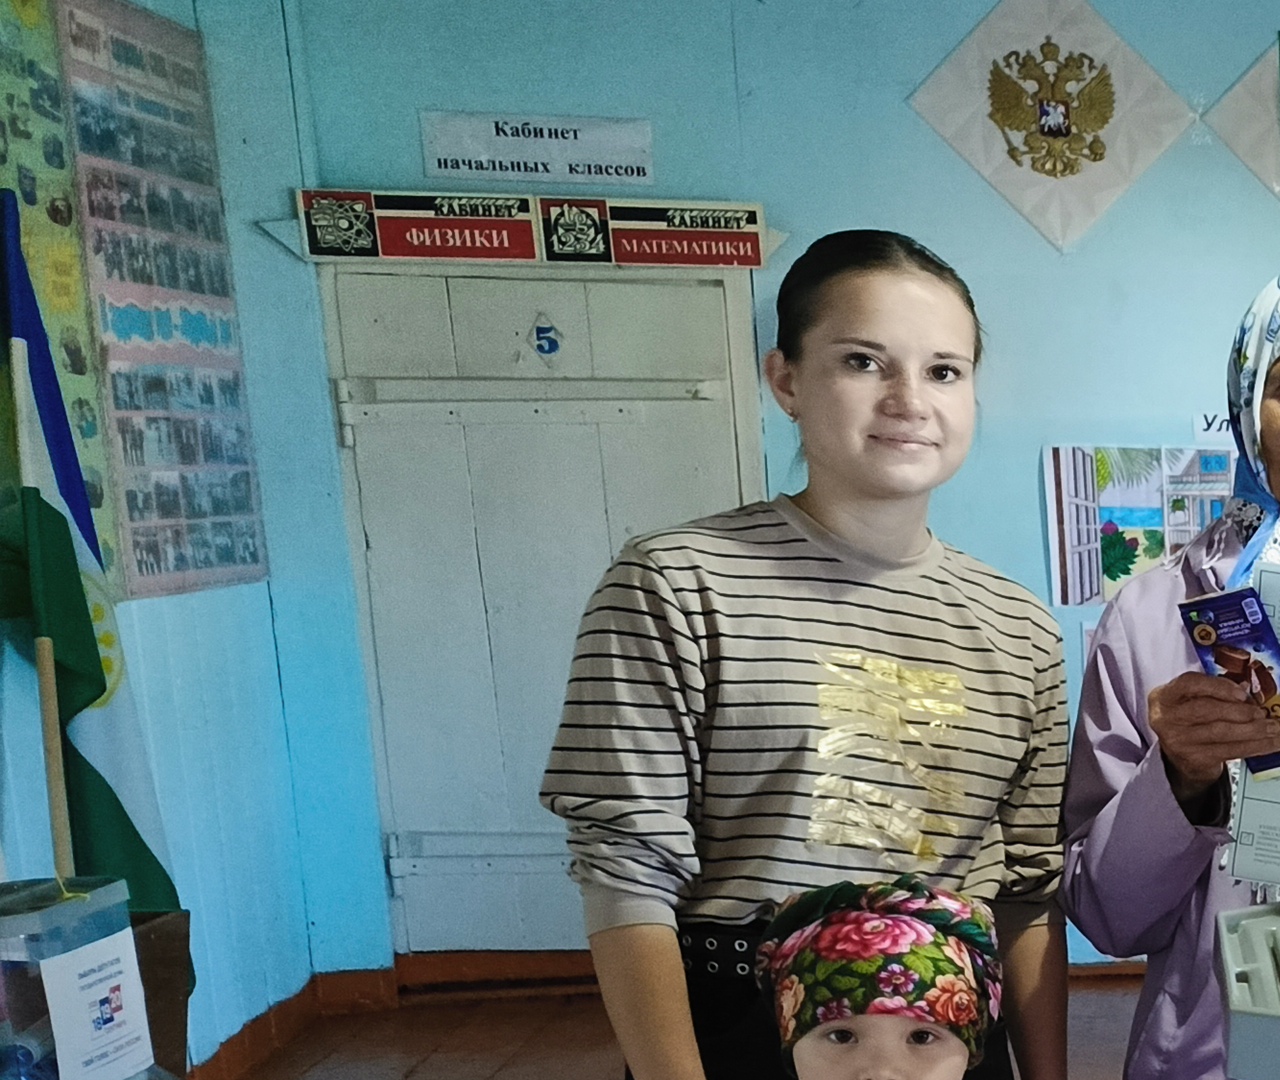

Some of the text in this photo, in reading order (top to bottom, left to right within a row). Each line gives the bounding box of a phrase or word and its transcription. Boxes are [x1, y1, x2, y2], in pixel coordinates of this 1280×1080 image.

[493, 120, 581, 141] Кабинет
[436, 156, 648, 178] начальных классов
[434, 198, 520, 218] КАБИНЕТ
[666, 206, 747, 229] КАБИНЕТ
[404, 227, 510, 248] ФИЗИКИ
[620, 238, 753, 257] МАТЕМАТИКИ
[535, 325, 560, 355] 5
[1202, 413, 1231, 433] Ул
